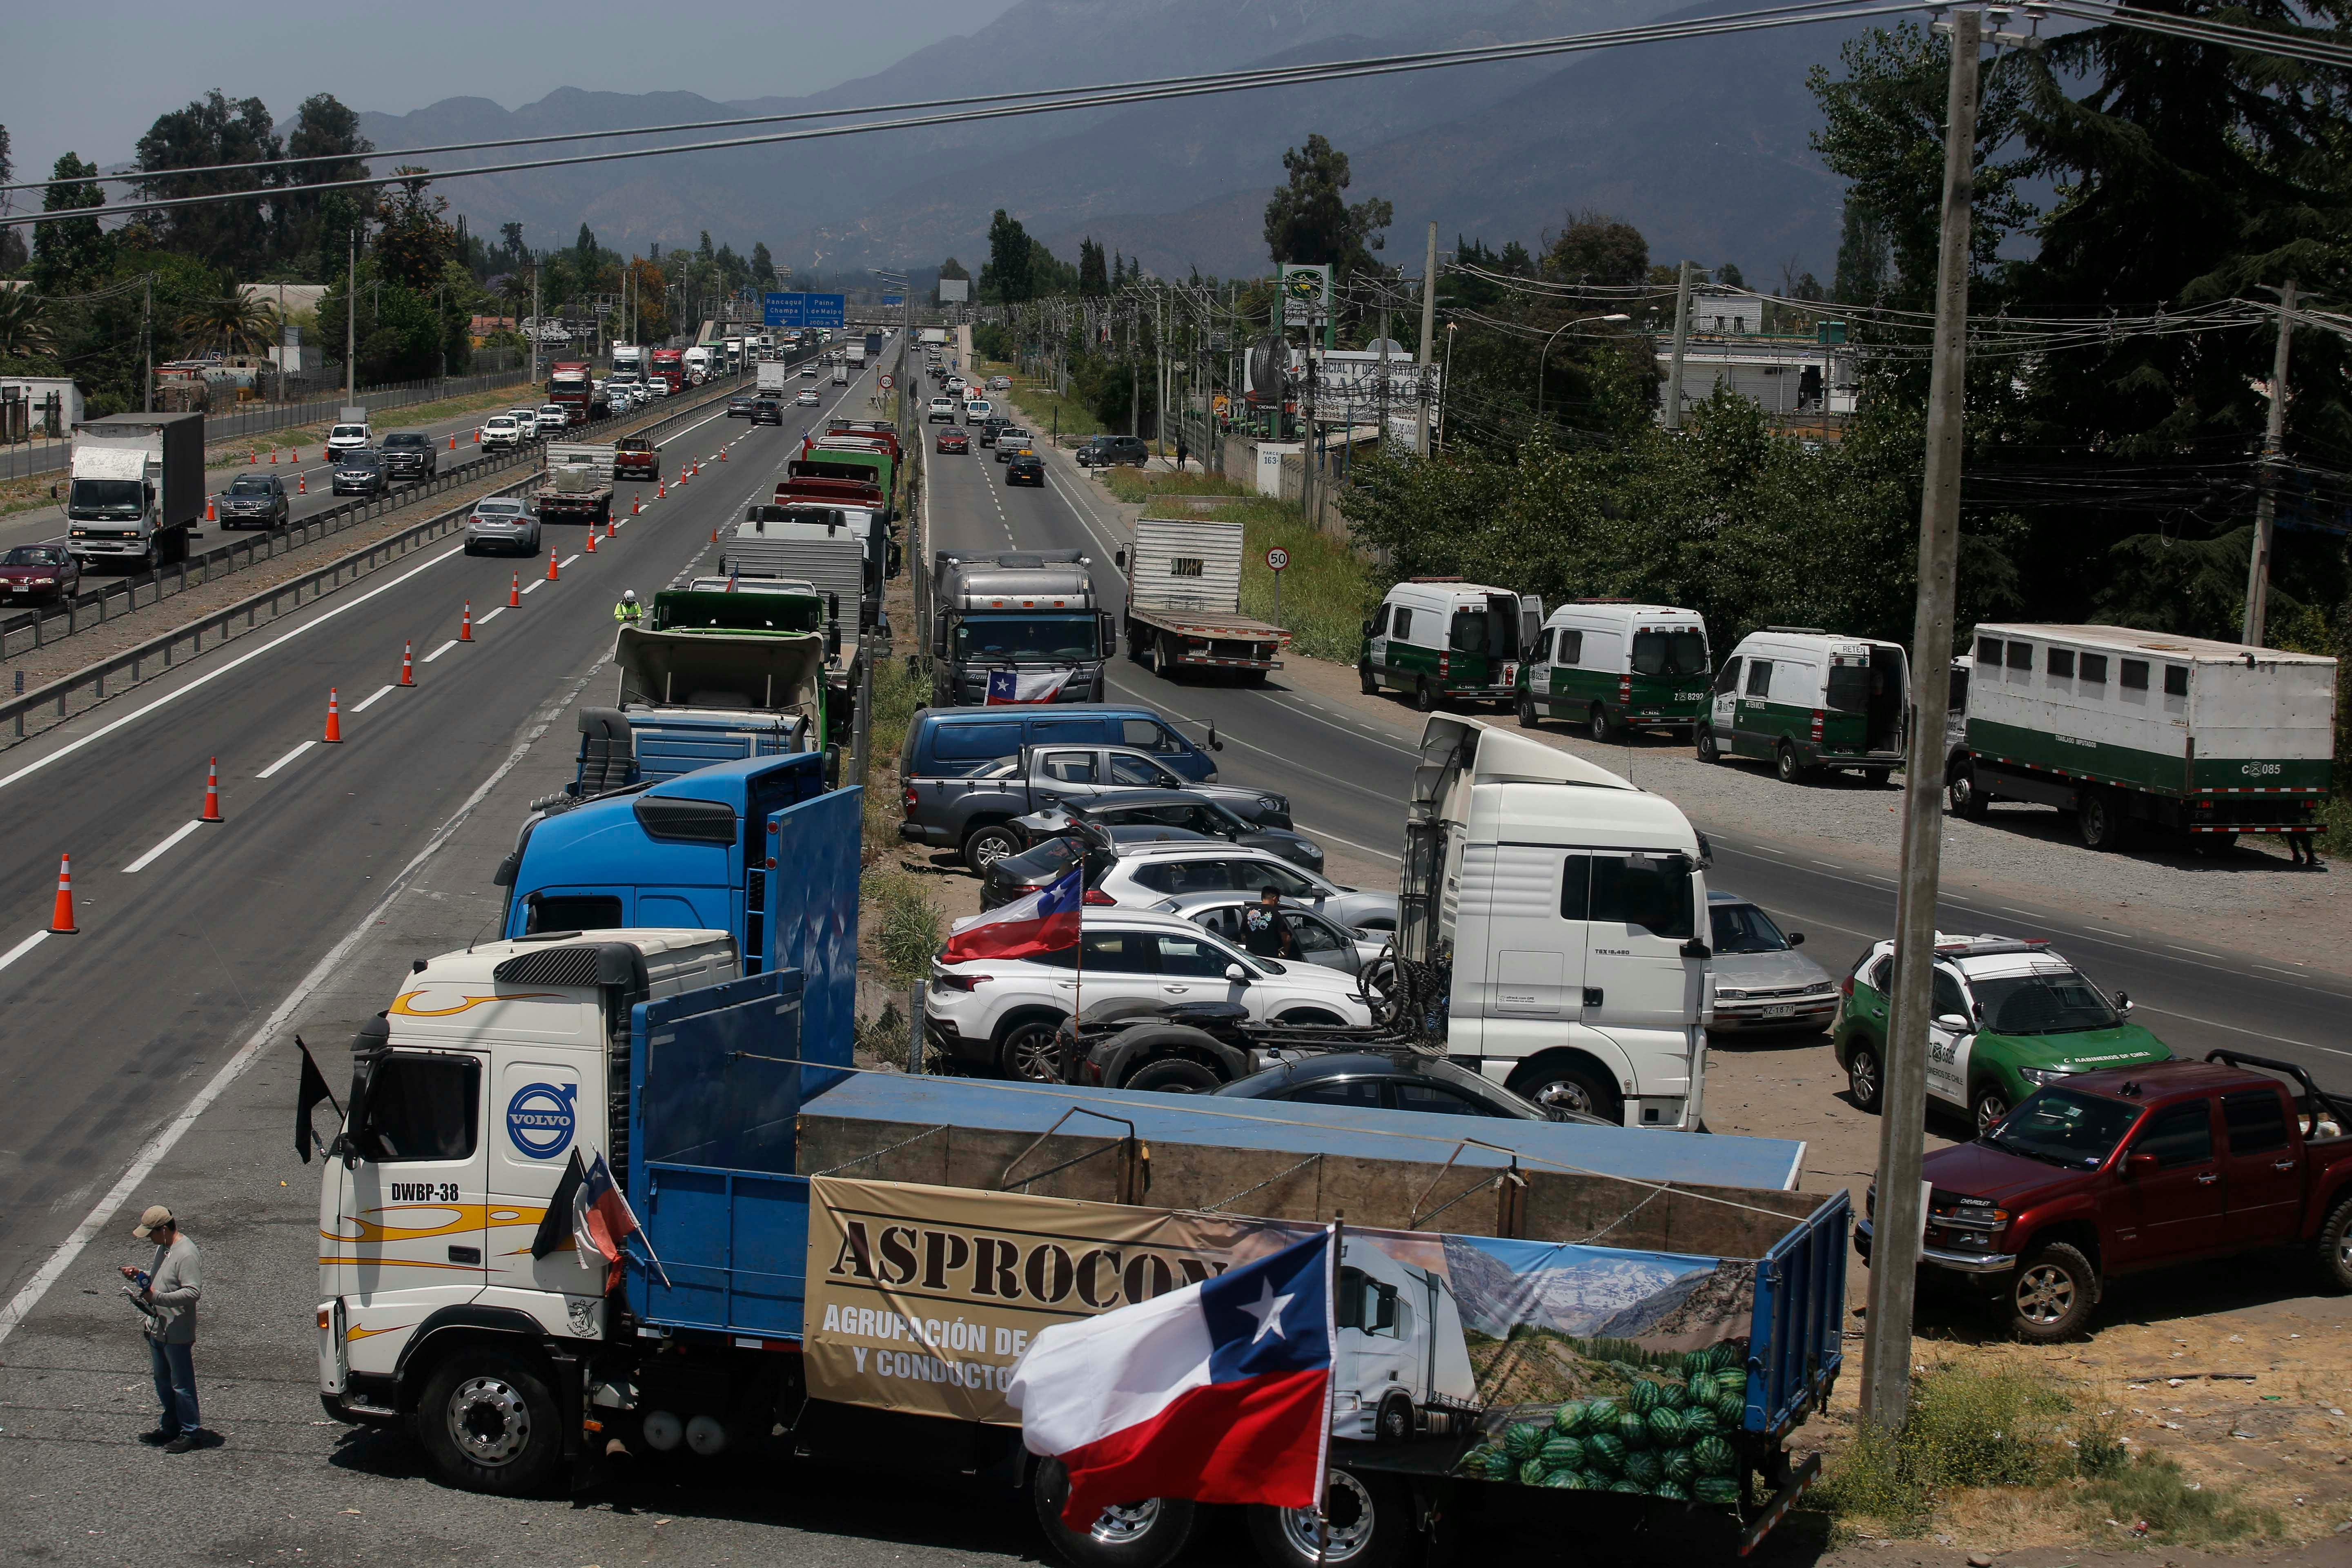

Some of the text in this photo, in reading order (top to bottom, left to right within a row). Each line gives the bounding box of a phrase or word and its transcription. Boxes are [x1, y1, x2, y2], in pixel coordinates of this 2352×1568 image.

[1404, 424, 1416, 436] LOGIS
[1271, 553, 1285, 564] 50
[1687, 693, 1704, 701] 8292
[1947, 722, 1956, 731] 085
[2242, 764, 2281, 774] C 085
[1942, 1047, 1955, 1065] 8526
[1927, 1066, 1963, 1086] BINEROS DE CHILE
[509, 1114, 570, 1126] VOLVO
[392, 1183, 459, 1202] DWBP-38
[566, 1323, 581, 1337] VIGILADO
[822, 1303, 1027, 1357] AGRUPACIÓN DE
[853, 1346, 1012, 1392] Y CONDUCTO
